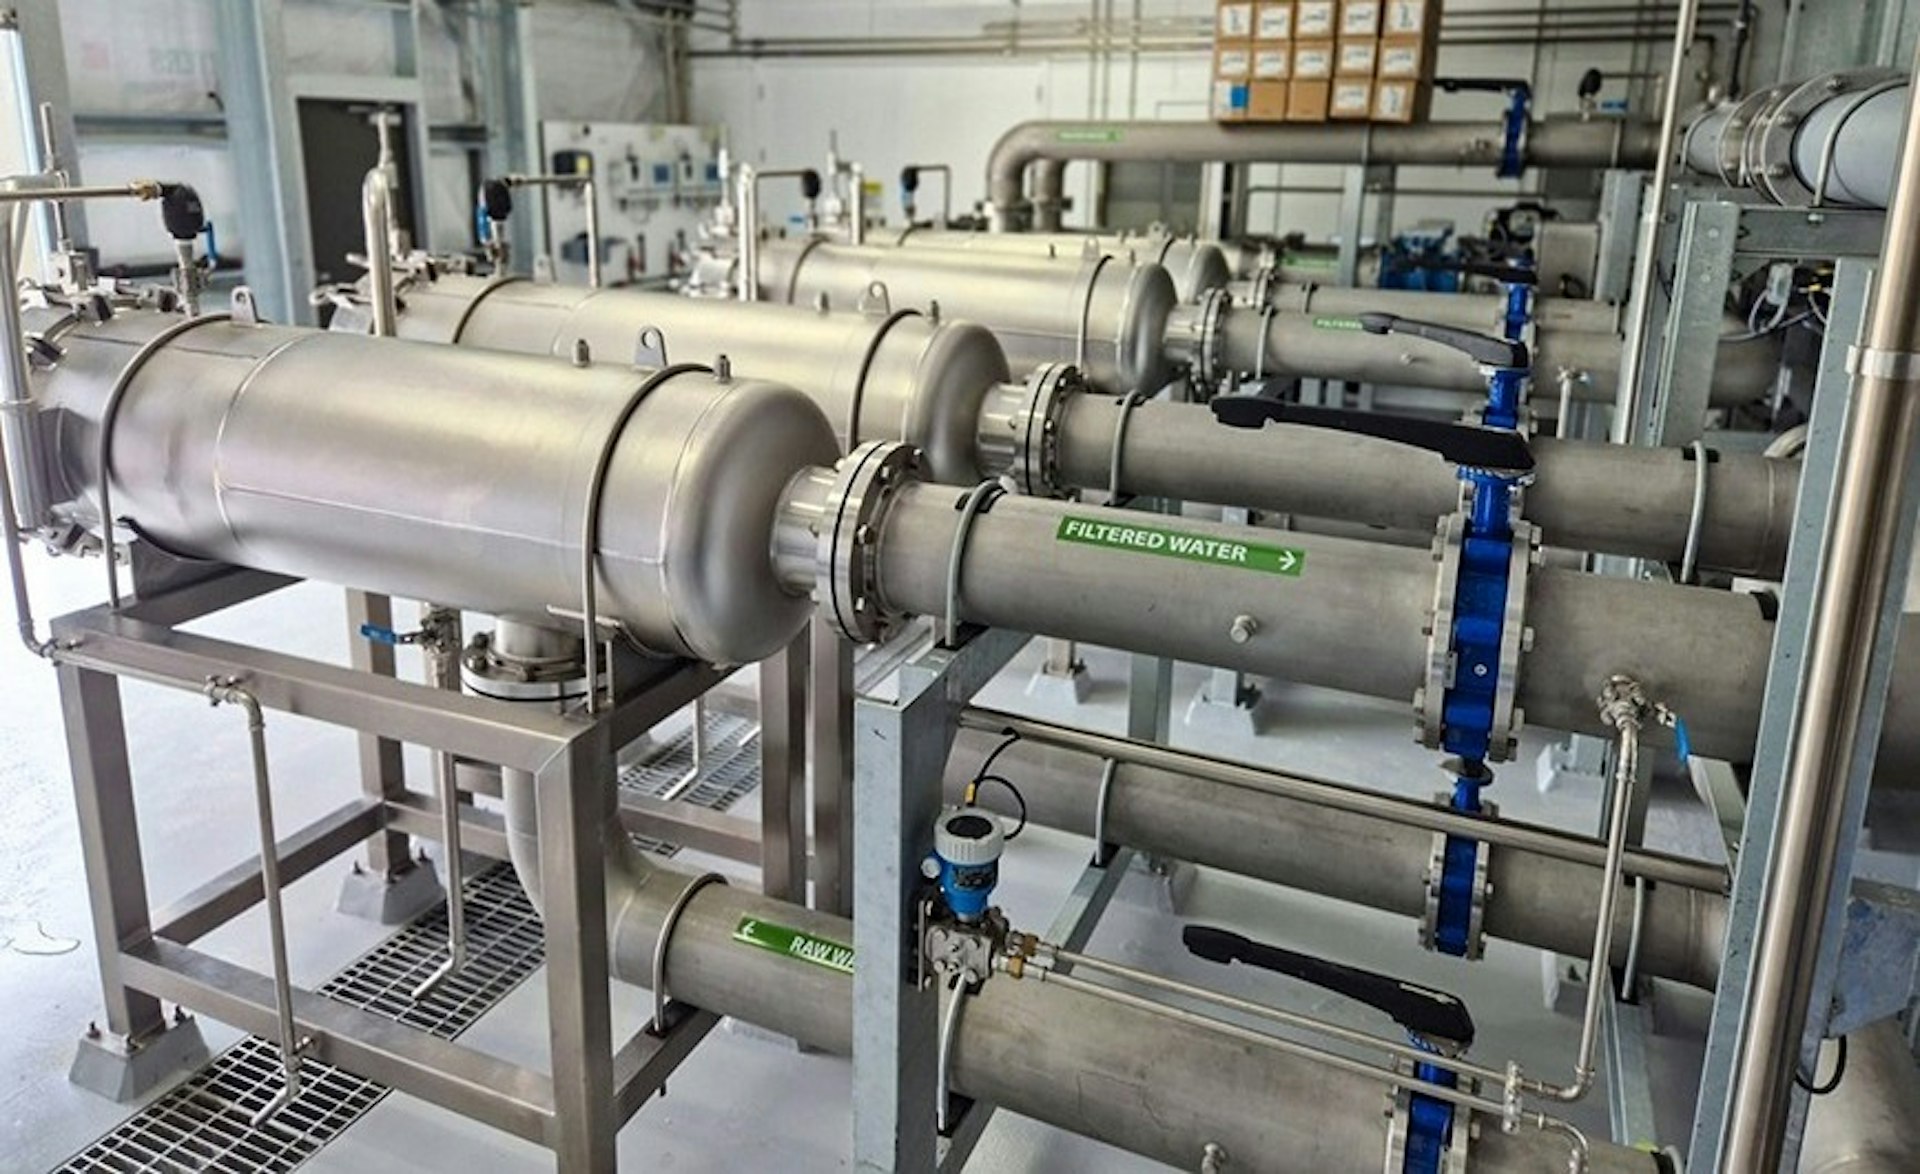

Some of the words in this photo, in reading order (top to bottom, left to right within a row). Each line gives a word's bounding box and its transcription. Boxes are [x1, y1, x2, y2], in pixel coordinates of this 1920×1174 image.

[1065, 520, 1165, 549] FILTERED
[1169, 535, 1248, 562] WATER
[789, 935, 832, 959] RAW
